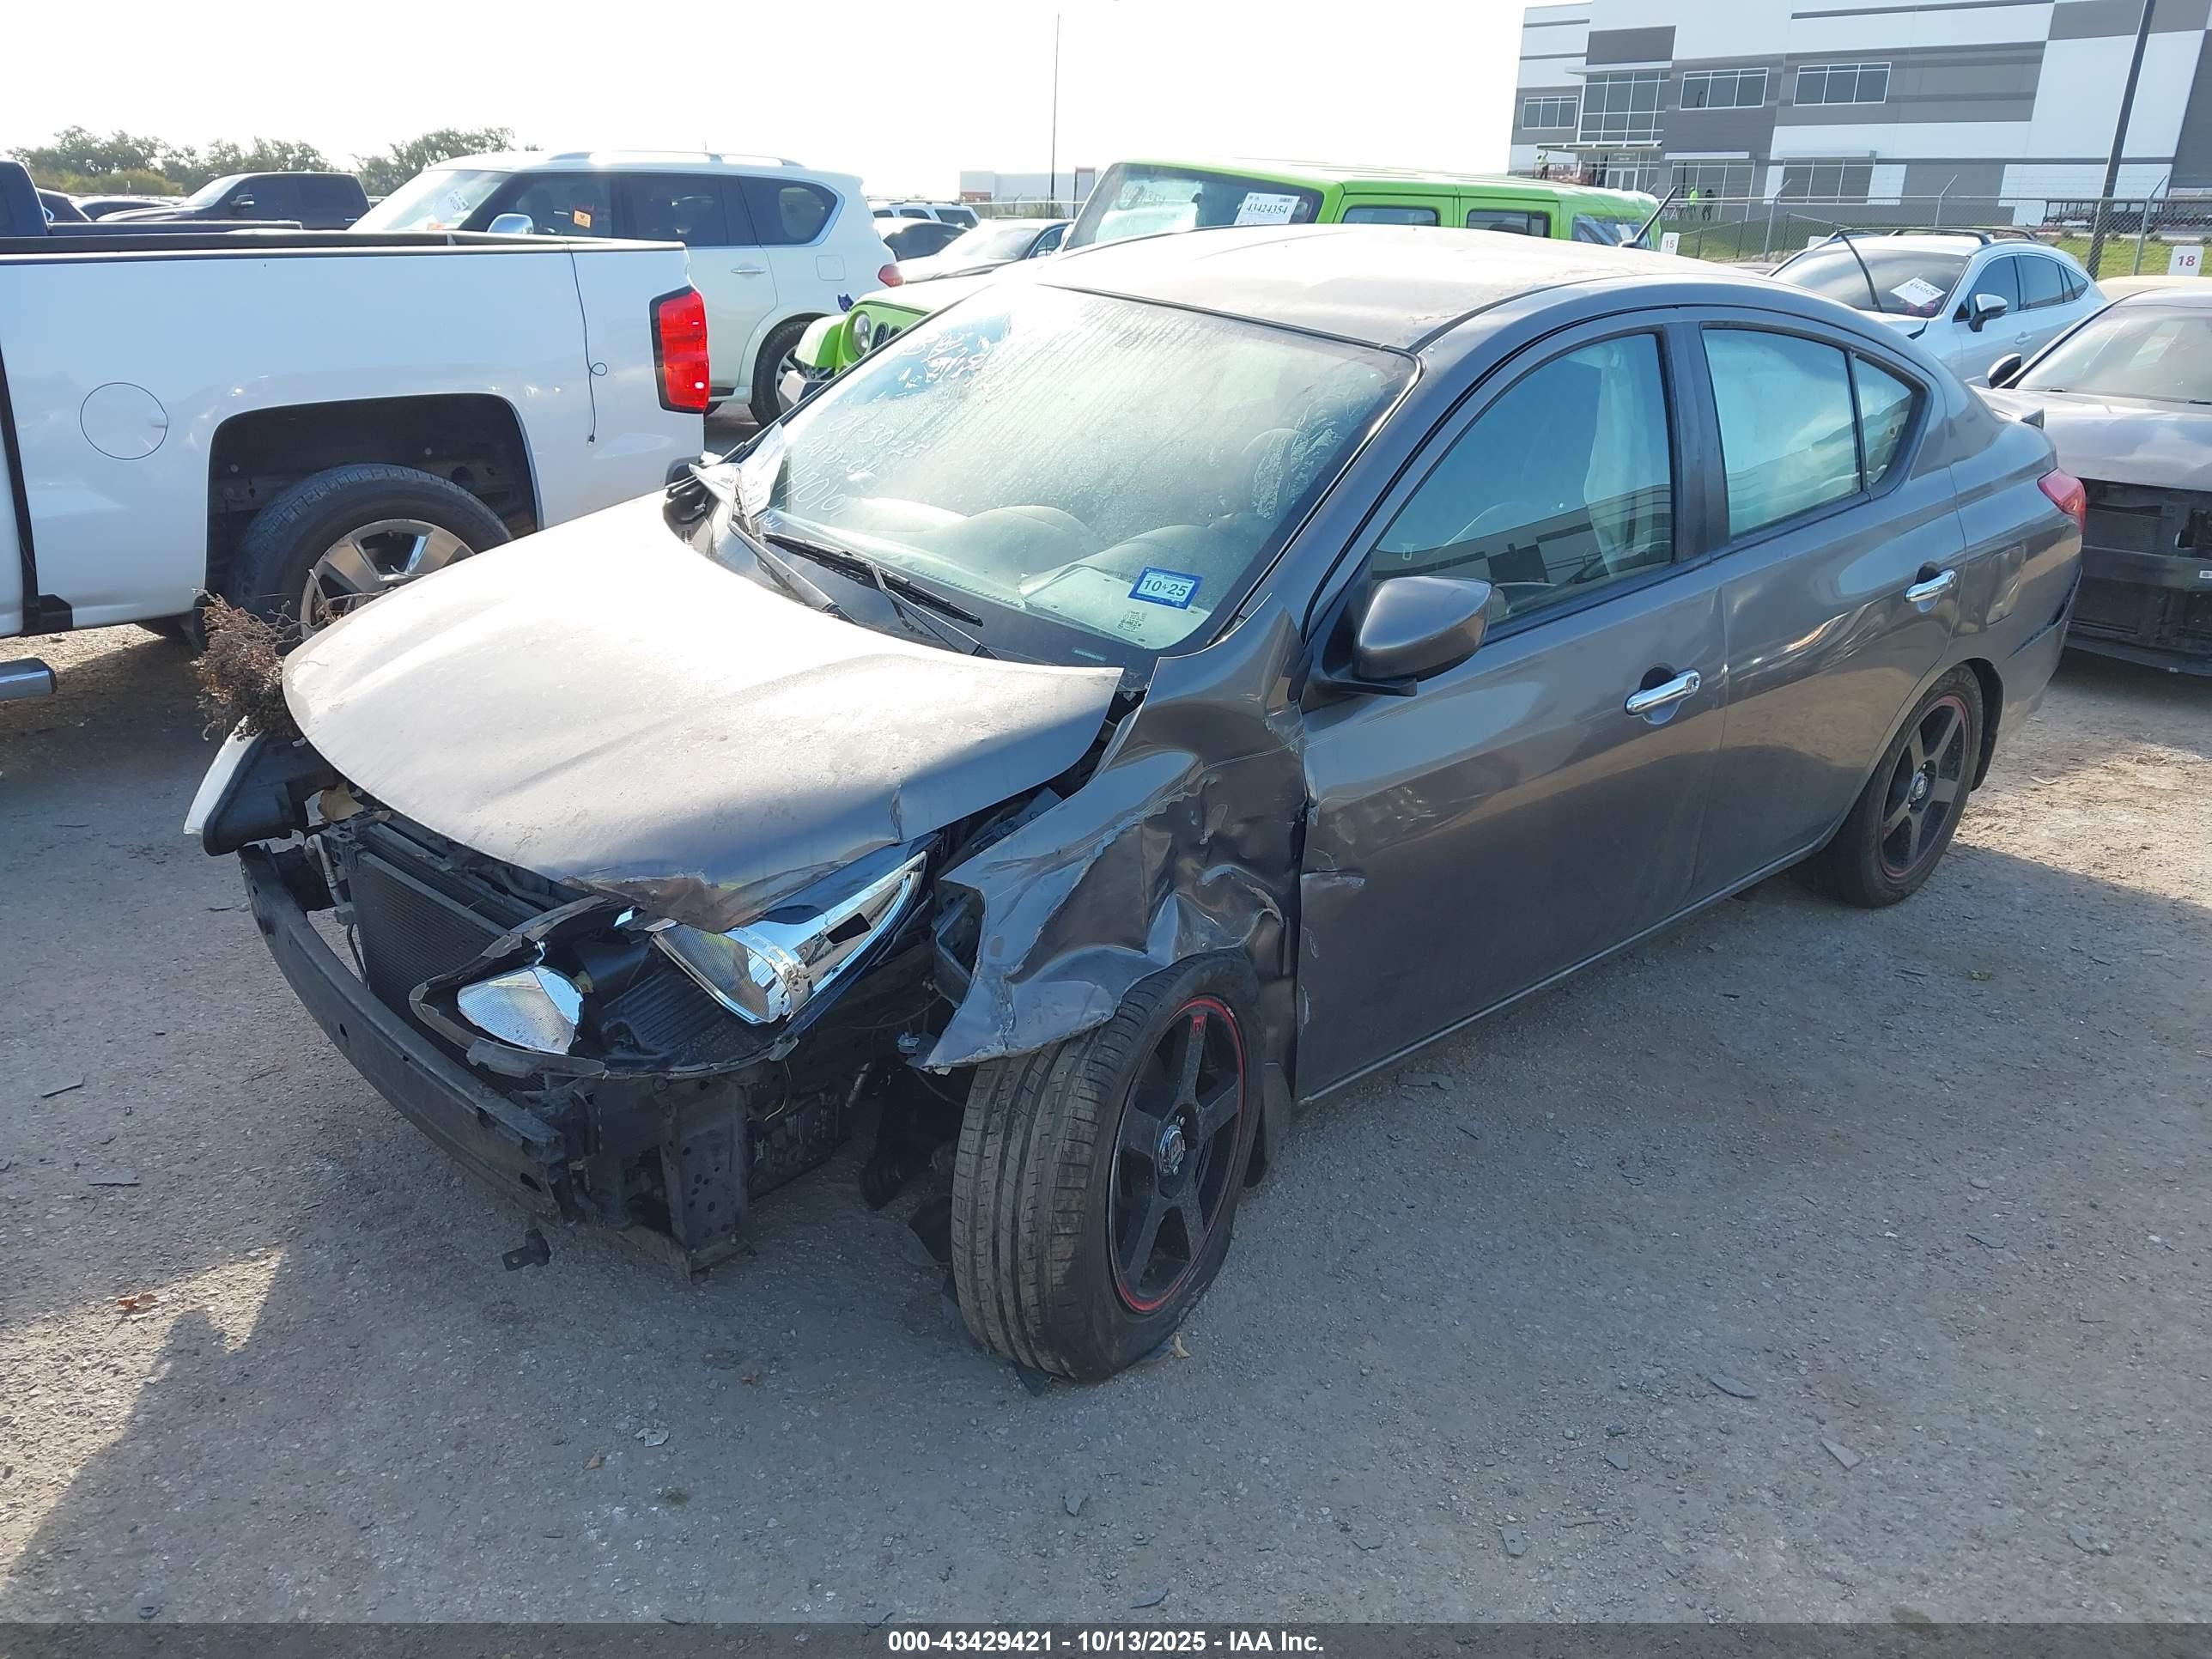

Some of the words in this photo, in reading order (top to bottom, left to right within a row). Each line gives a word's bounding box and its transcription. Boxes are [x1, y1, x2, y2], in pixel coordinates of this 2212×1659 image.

[1246, 204, 1288, 215] 43424354
[2178, 255, 2196, 266] 18
[1145, 579, 1163, 592] 10
[1167, 583, 1188, 597] 25
